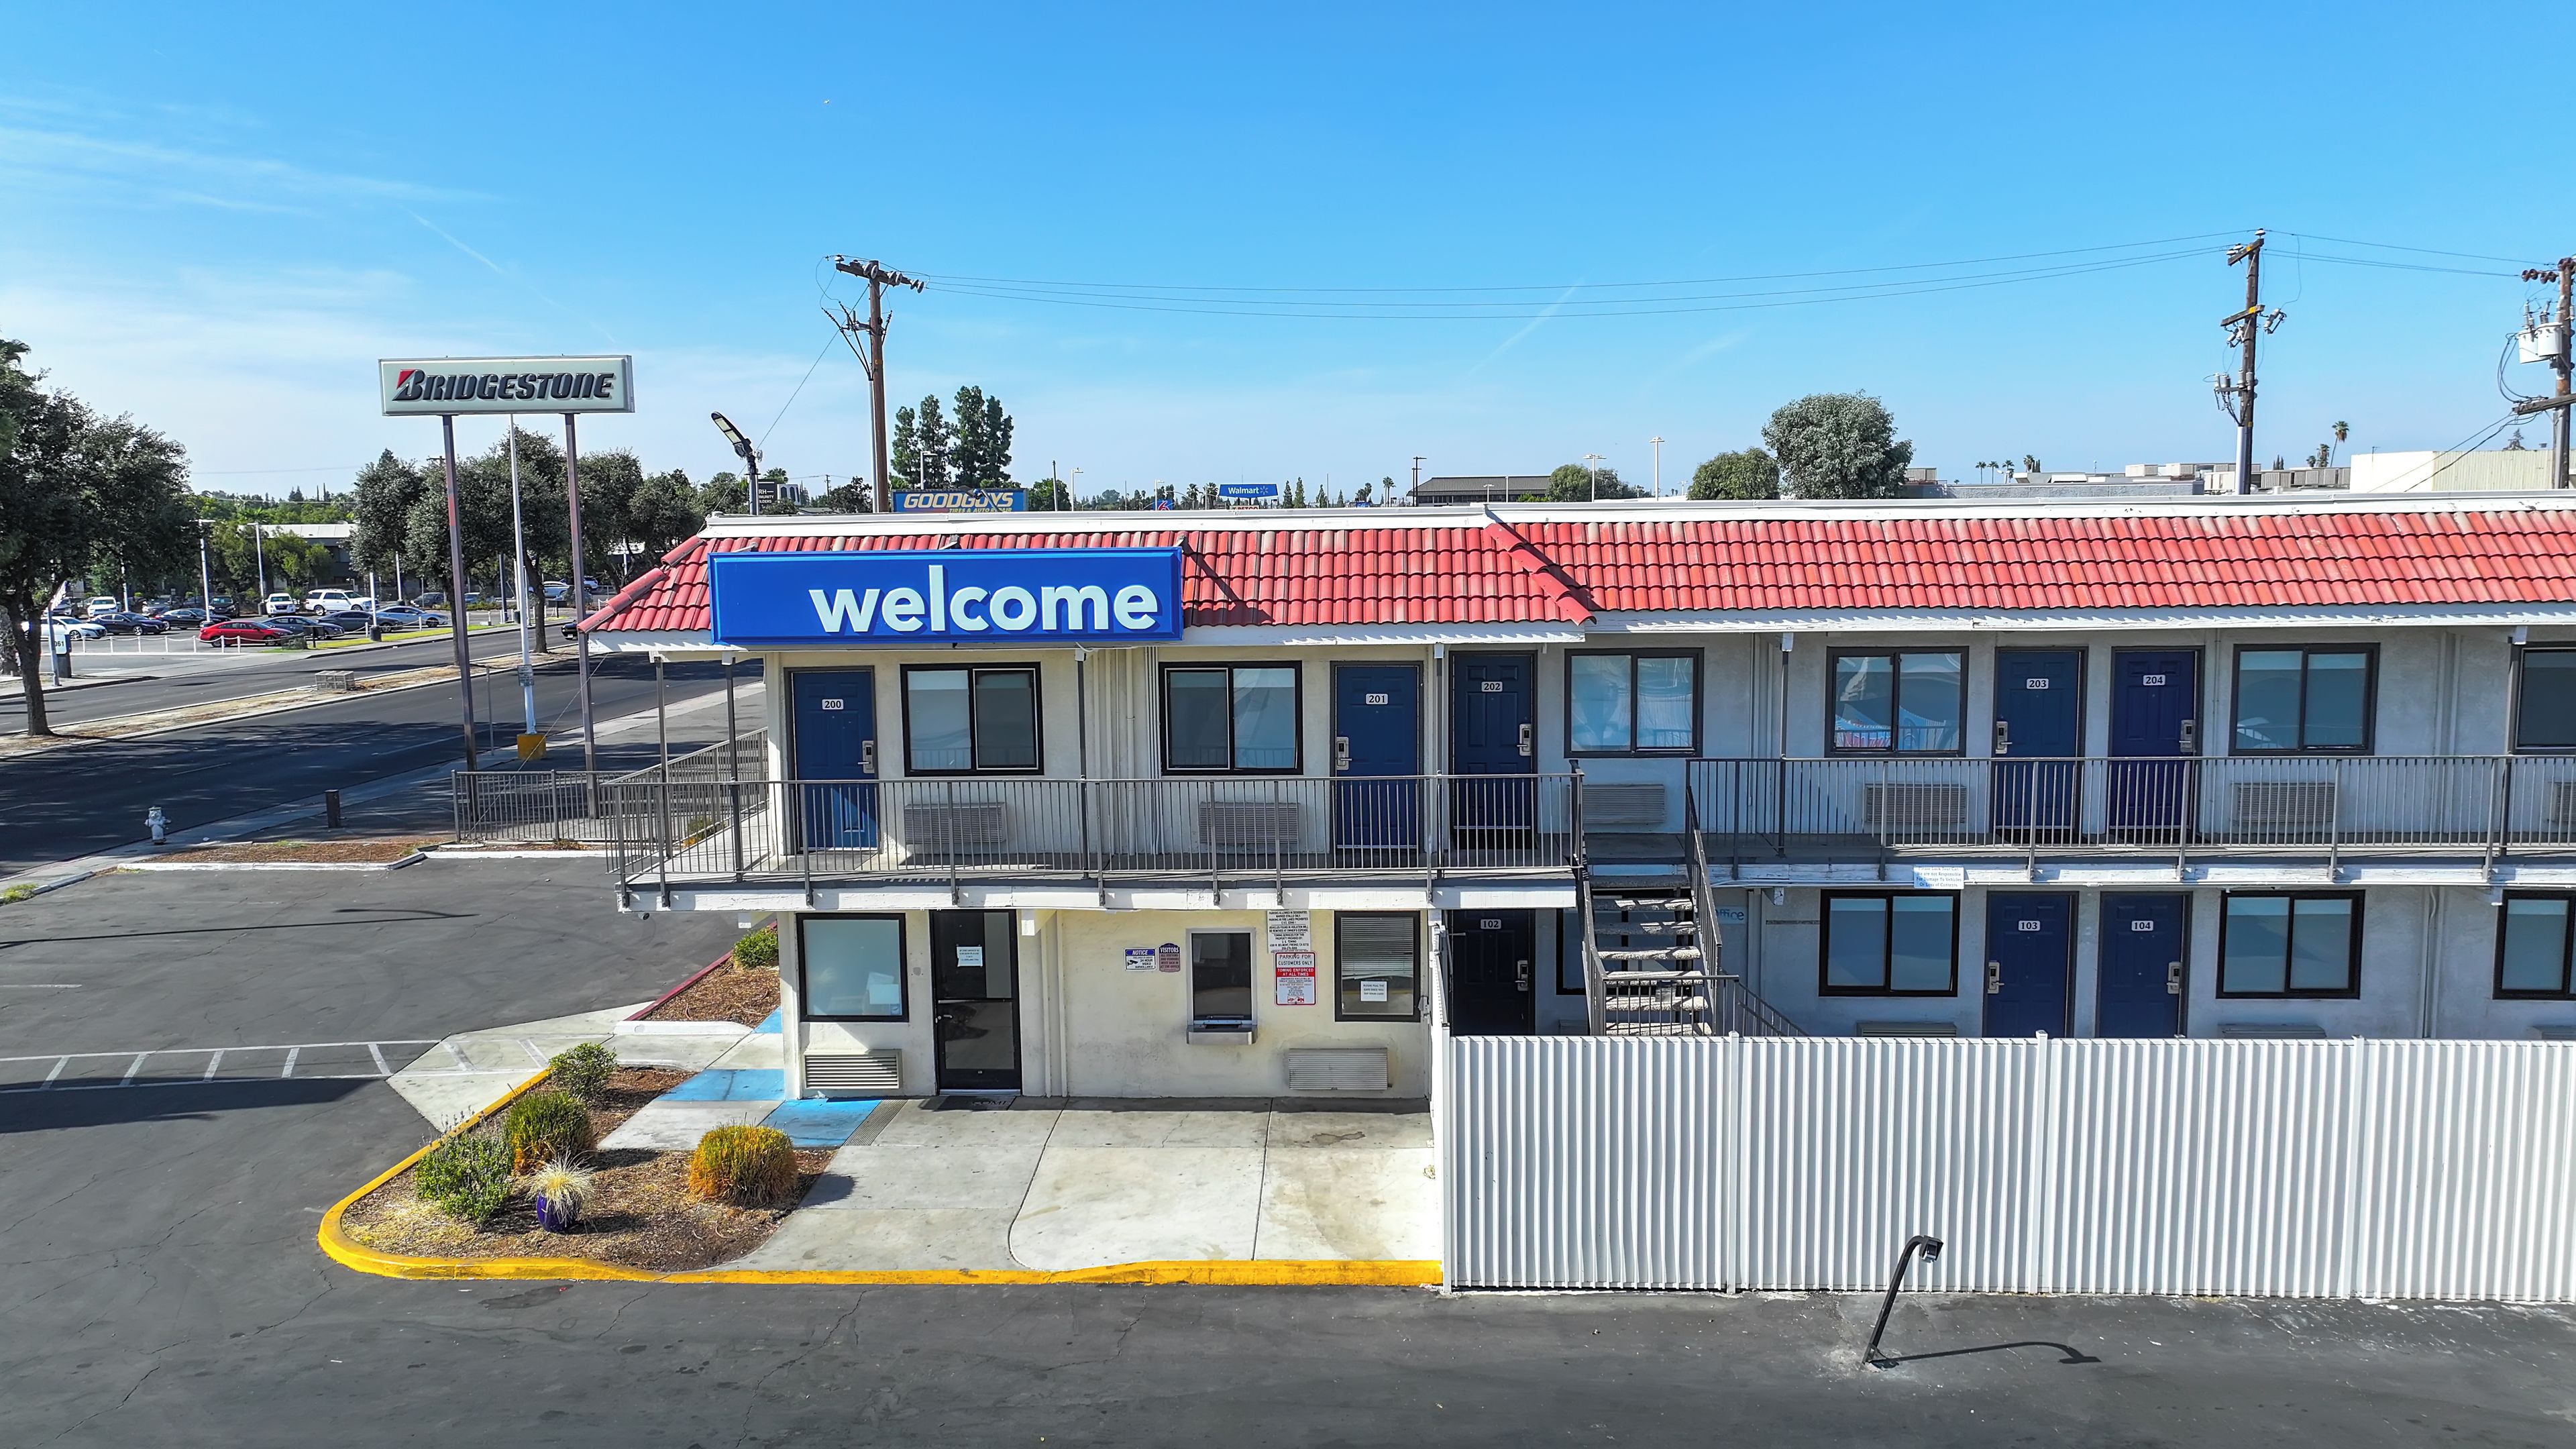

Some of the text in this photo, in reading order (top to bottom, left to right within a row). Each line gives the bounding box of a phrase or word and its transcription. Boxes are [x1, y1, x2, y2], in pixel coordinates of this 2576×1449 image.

[392, 369, 614, 401] BRIDGESTONE
[809, 564, 1158, 632] welcome
[2029, 680, 2046, 688] 203
[2145, 676, 2163, 684] 204
[1483, 920, 1499, 928] 102
